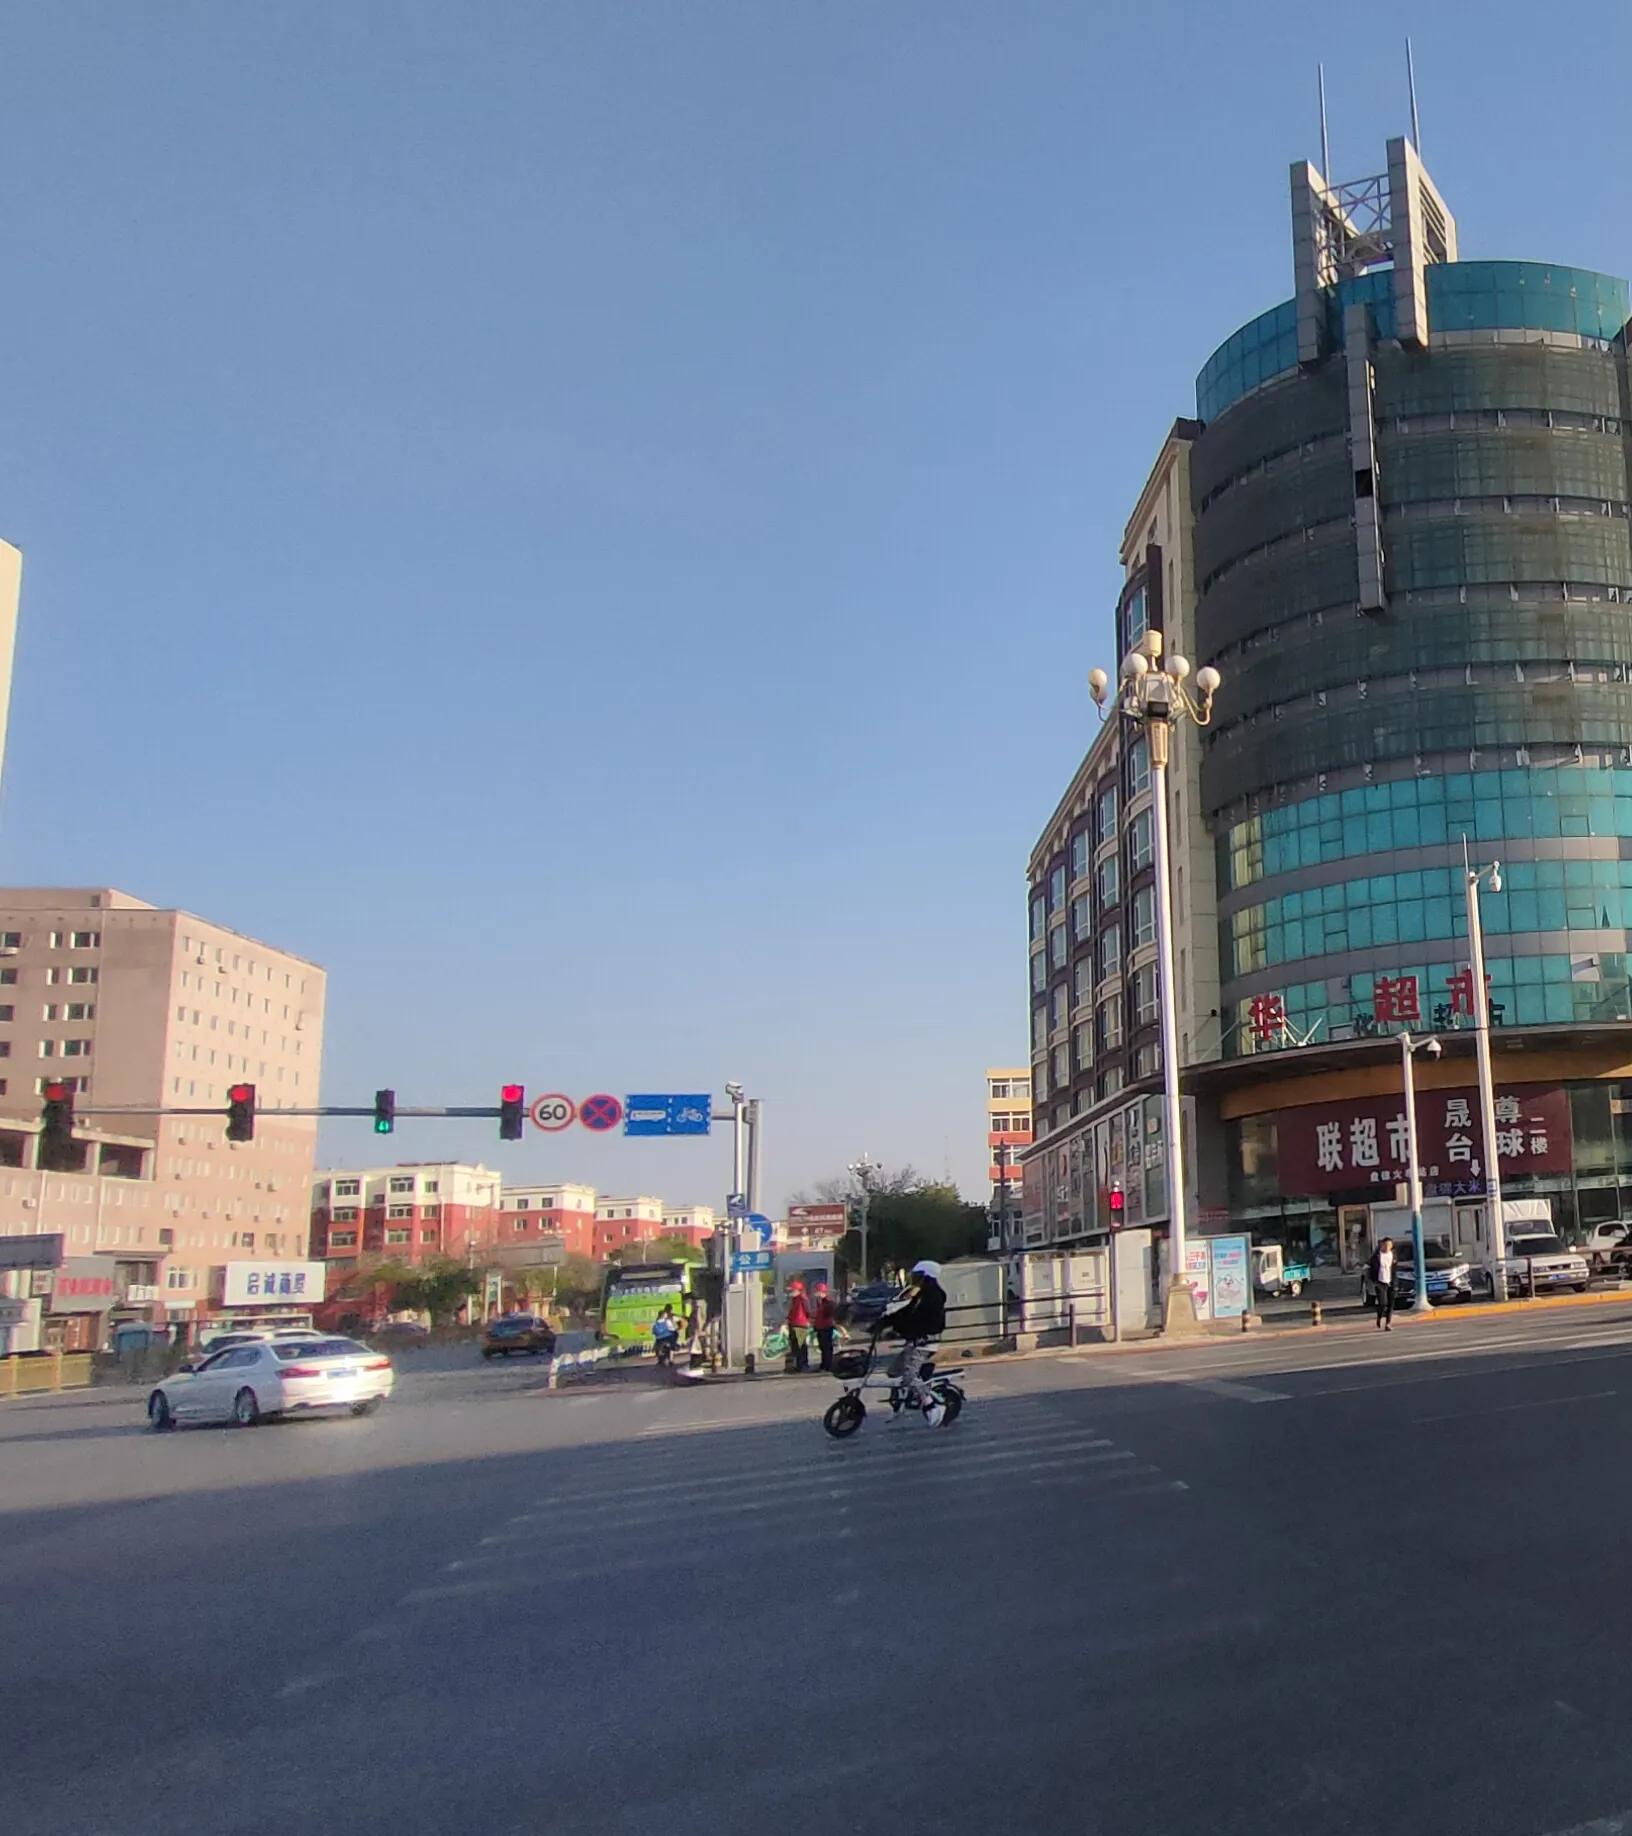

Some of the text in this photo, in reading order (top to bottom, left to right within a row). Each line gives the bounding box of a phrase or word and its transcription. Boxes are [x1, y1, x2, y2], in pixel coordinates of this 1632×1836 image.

[538, 1103, 568, 1121] 60
[1316, 1112, 1412, 1172] 联超市
[1529, 1116, 1549, 1155] 二楼
